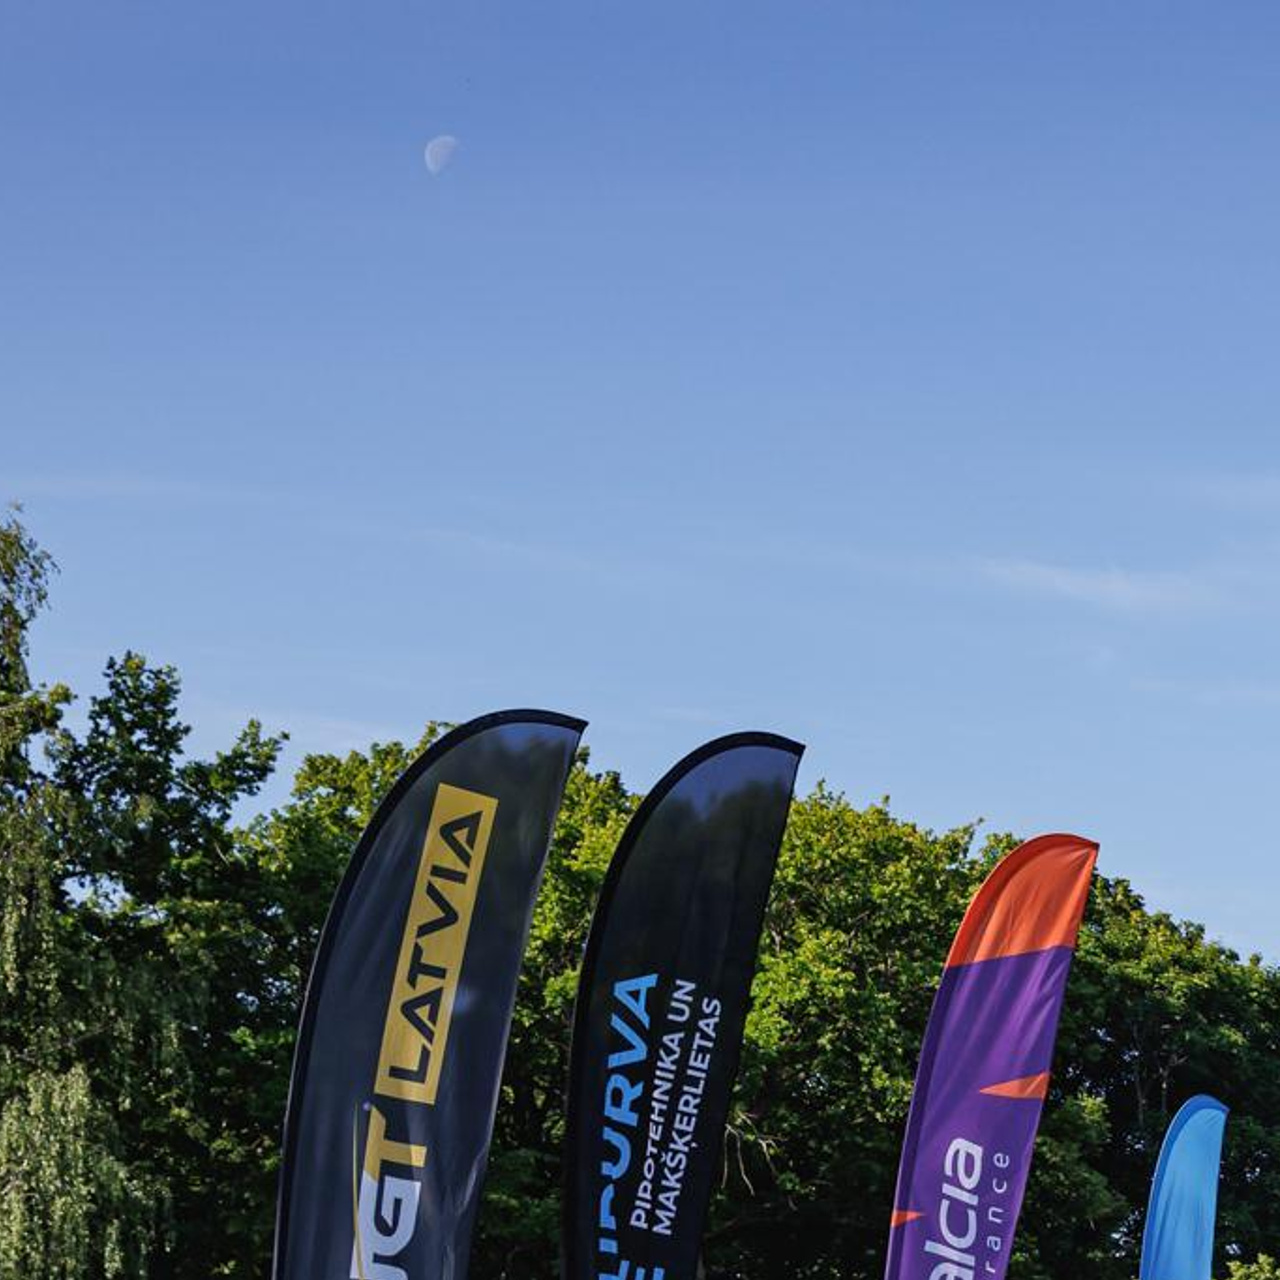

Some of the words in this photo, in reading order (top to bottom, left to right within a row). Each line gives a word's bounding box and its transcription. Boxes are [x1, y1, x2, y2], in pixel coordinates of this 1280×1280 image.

[390, 810, 483, 1085] LATVIA
[667, 979, 696, 1023] UN
[651, 997, 722, 1236] MAKŠĶERLIETAS
